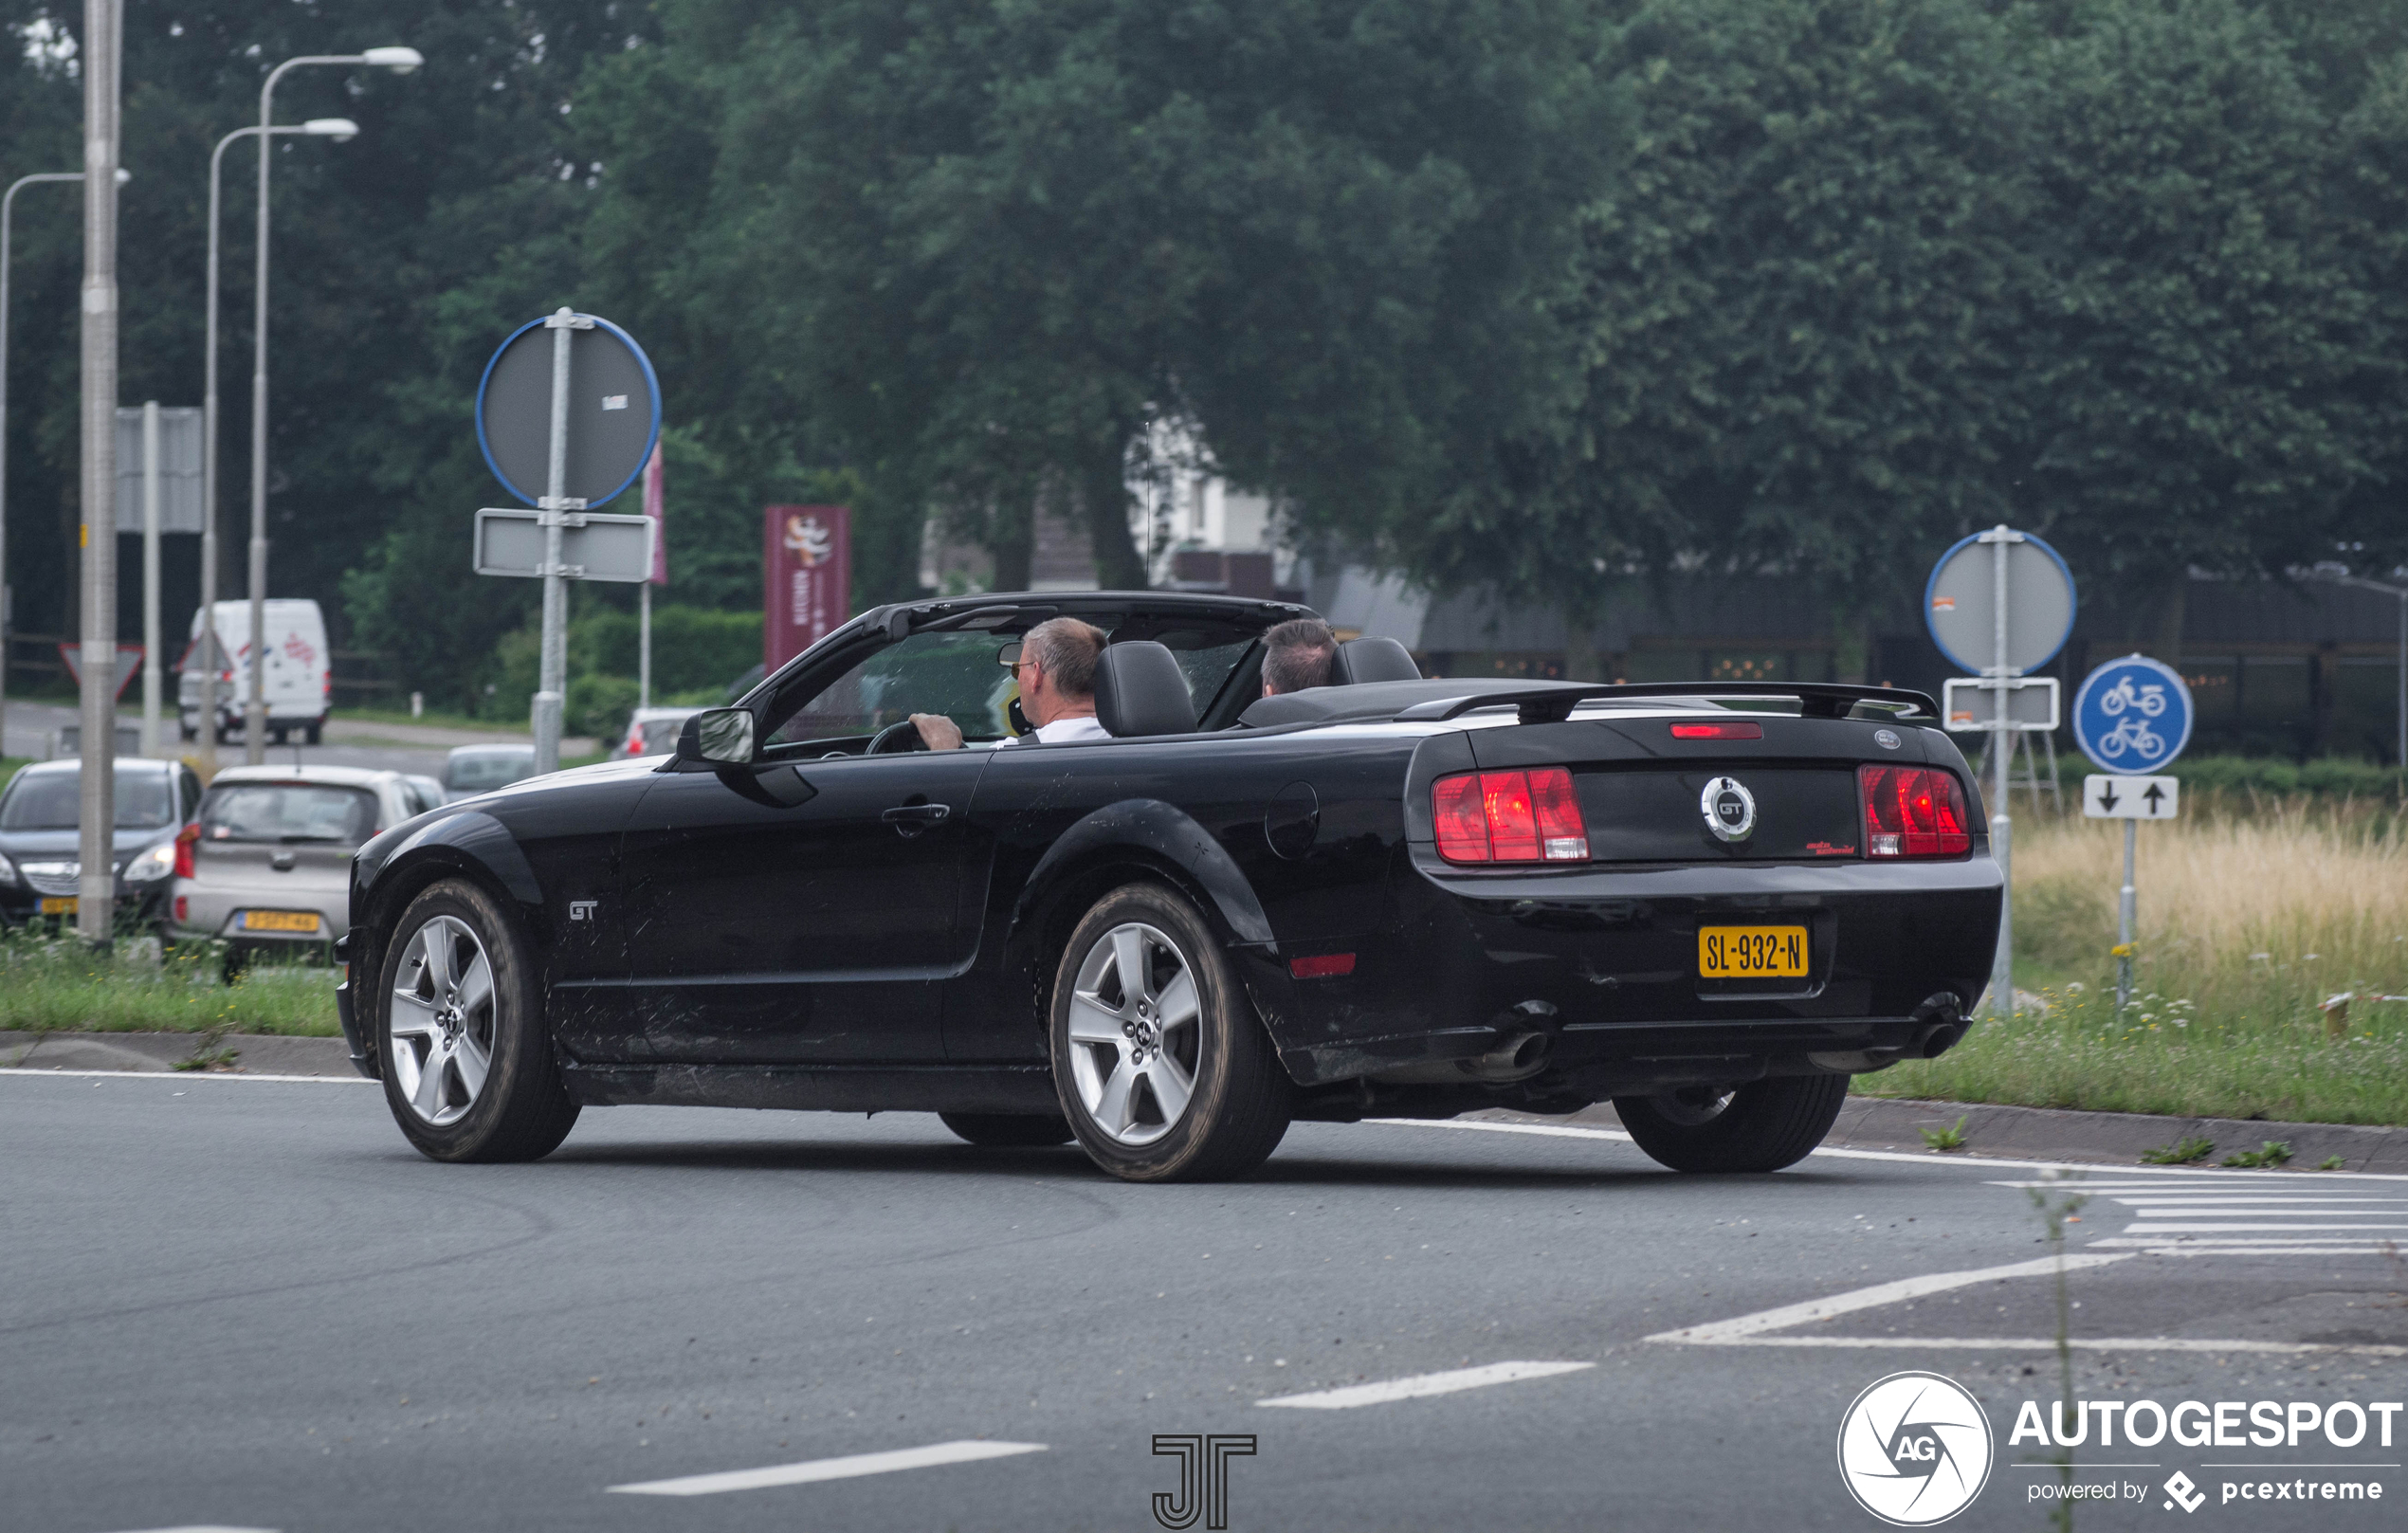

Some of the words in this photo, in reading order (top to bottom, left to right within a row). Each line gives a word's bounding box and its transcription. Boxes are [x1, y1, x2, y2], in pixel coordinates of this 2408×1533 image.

[1719, 802, 1742, 815] GT
[569, 901, 597, 920] GT
[1707, 934, 1800, 970] SL-932-N
